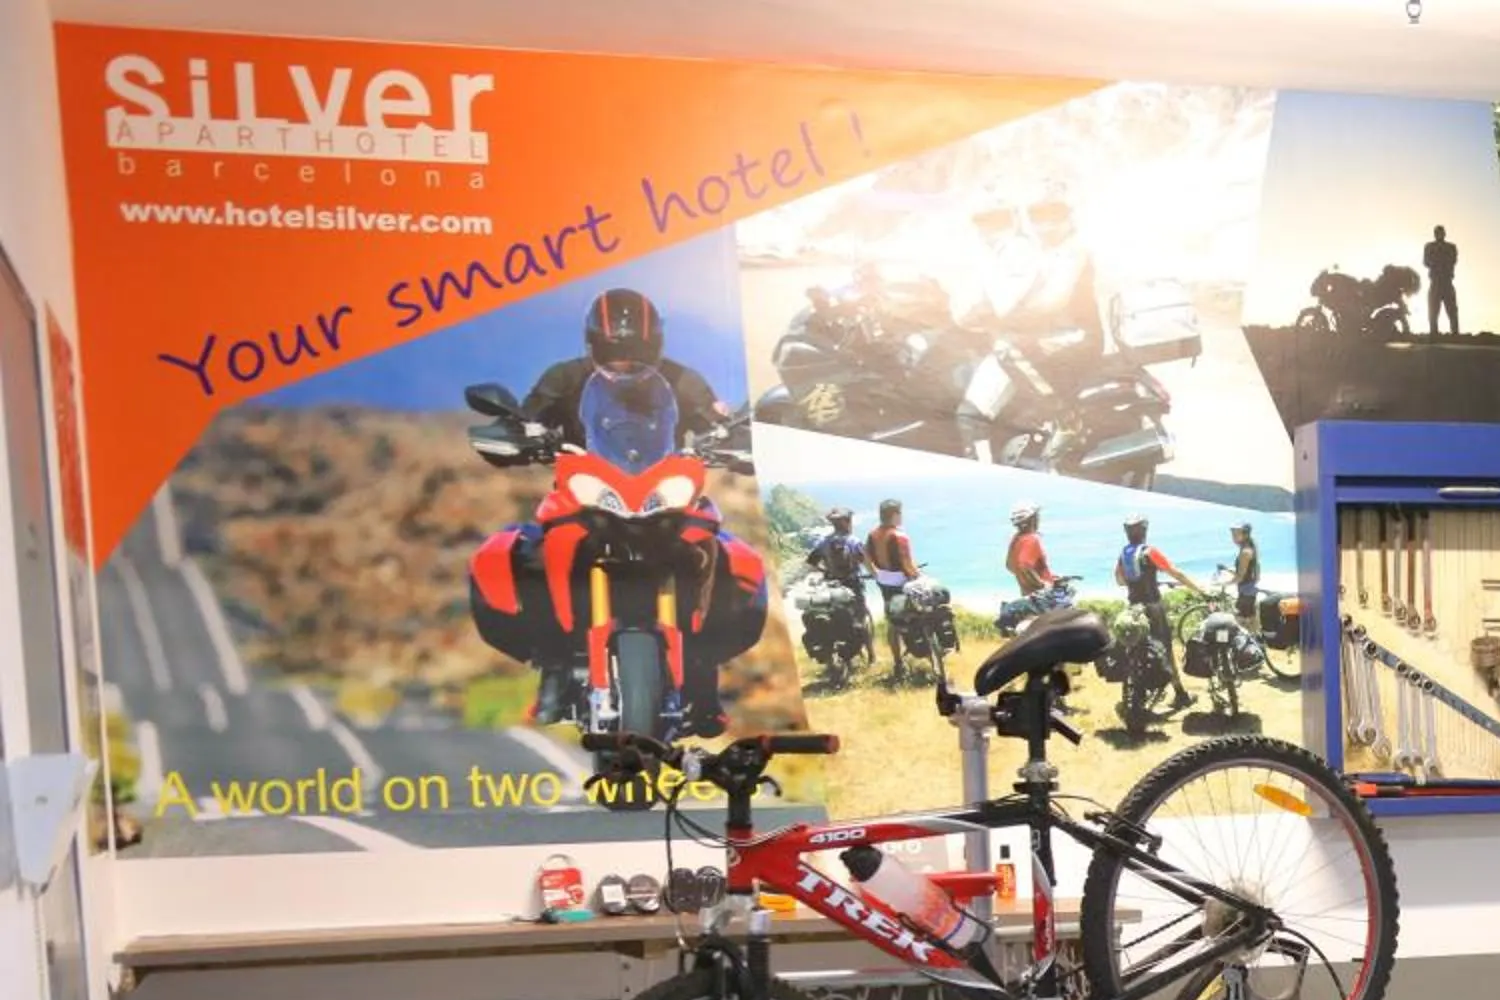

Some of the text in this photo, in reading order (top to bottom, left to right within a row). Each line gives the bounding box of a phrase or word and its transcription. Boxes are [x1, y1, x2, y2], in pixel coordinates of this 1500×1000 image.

[115, 119, 484, 161] APARTHOTEL
[118, 151, 484, 189] barcelona
[120, 201, 493, 235] www.hotelsilver.com
[159, 304, 353, 398] Your
[386, 204, 621, 327] smart
[640, 122, 826, 233] hotel
[156, 770, 199, 818] A
[211, 768, 362, 815] world
[382, 775, 450, 811] on
[470, 764, 563, 807] two
[809, 827, 867, 845] 4100
[797, 865, 935, 963] TREK
